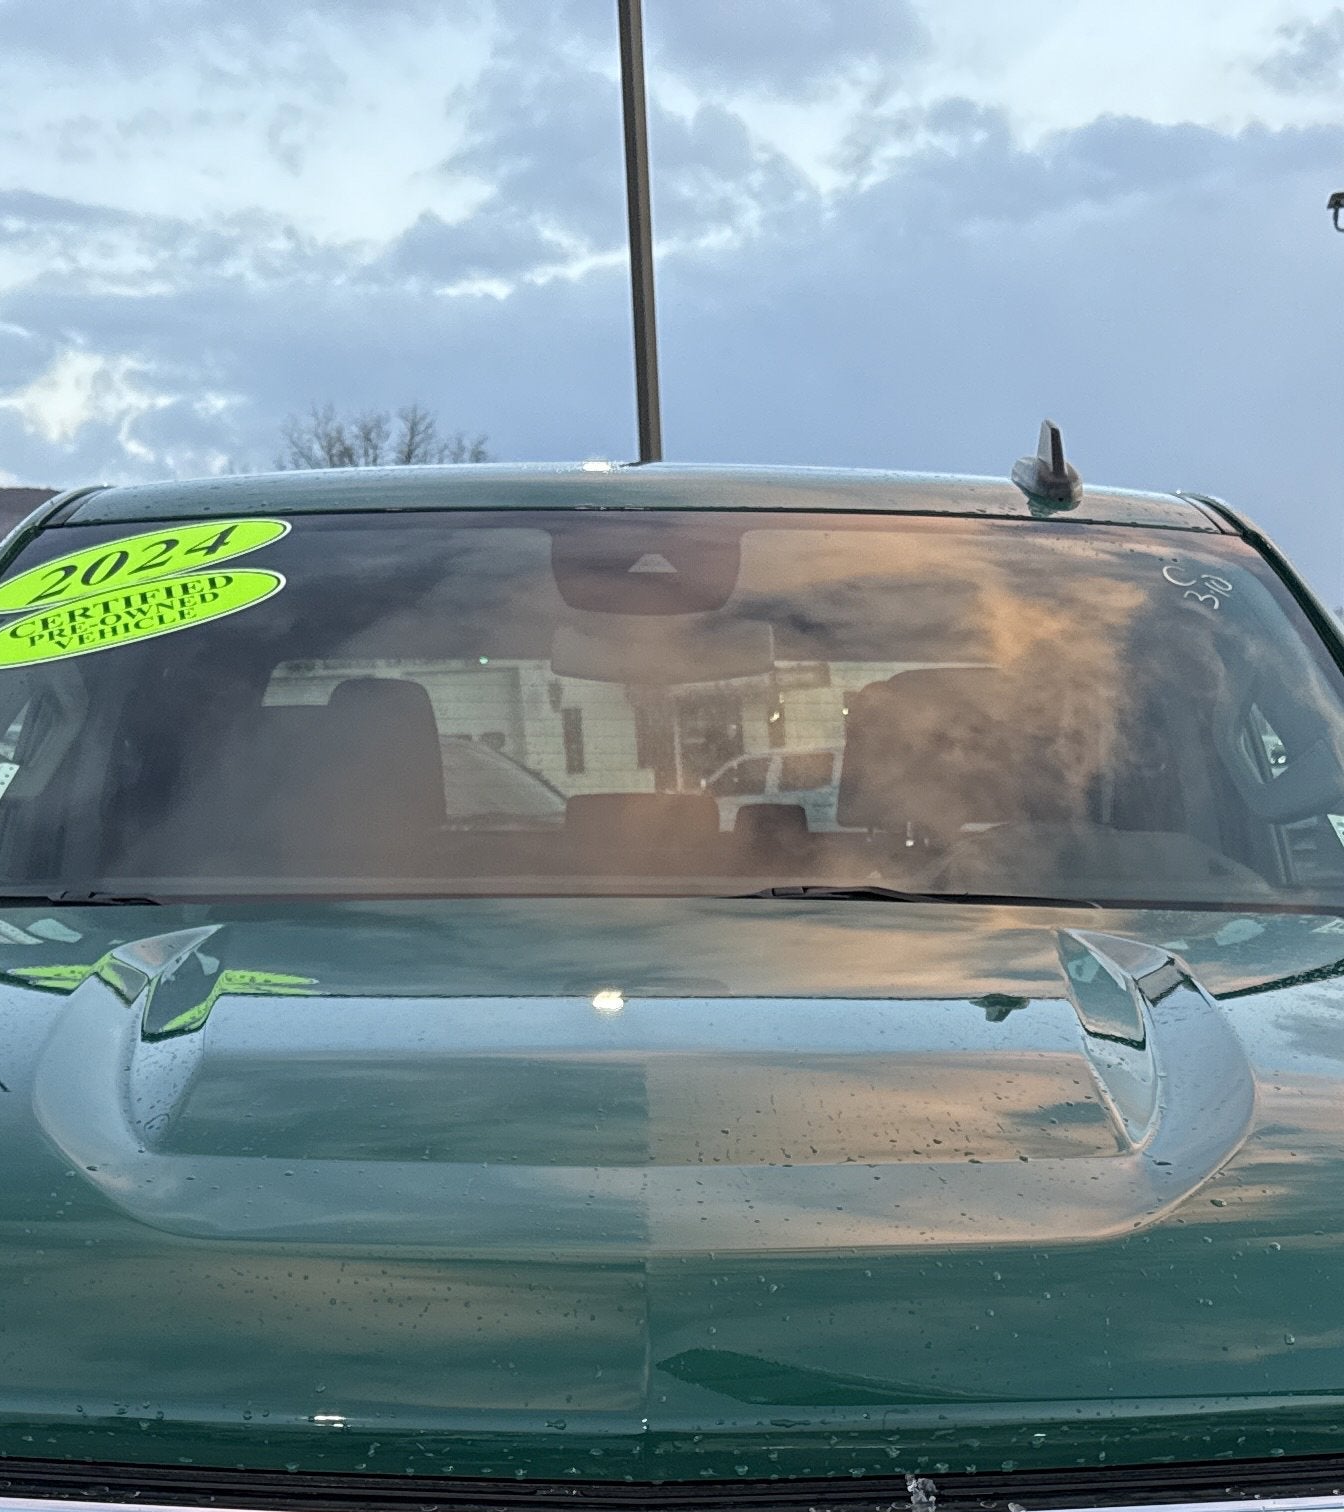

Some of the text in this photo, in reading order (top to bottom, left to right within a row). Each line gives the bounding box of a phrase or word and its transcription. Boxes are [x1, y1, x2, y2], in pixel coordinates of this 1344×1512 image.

[26, 525, 239, 605] 2024
[9, 575, 234, 639] CERTIFIED
[28, 591, 220, 648] PRE-OWNED
[54, 607, 198, 650] VEHICLE
